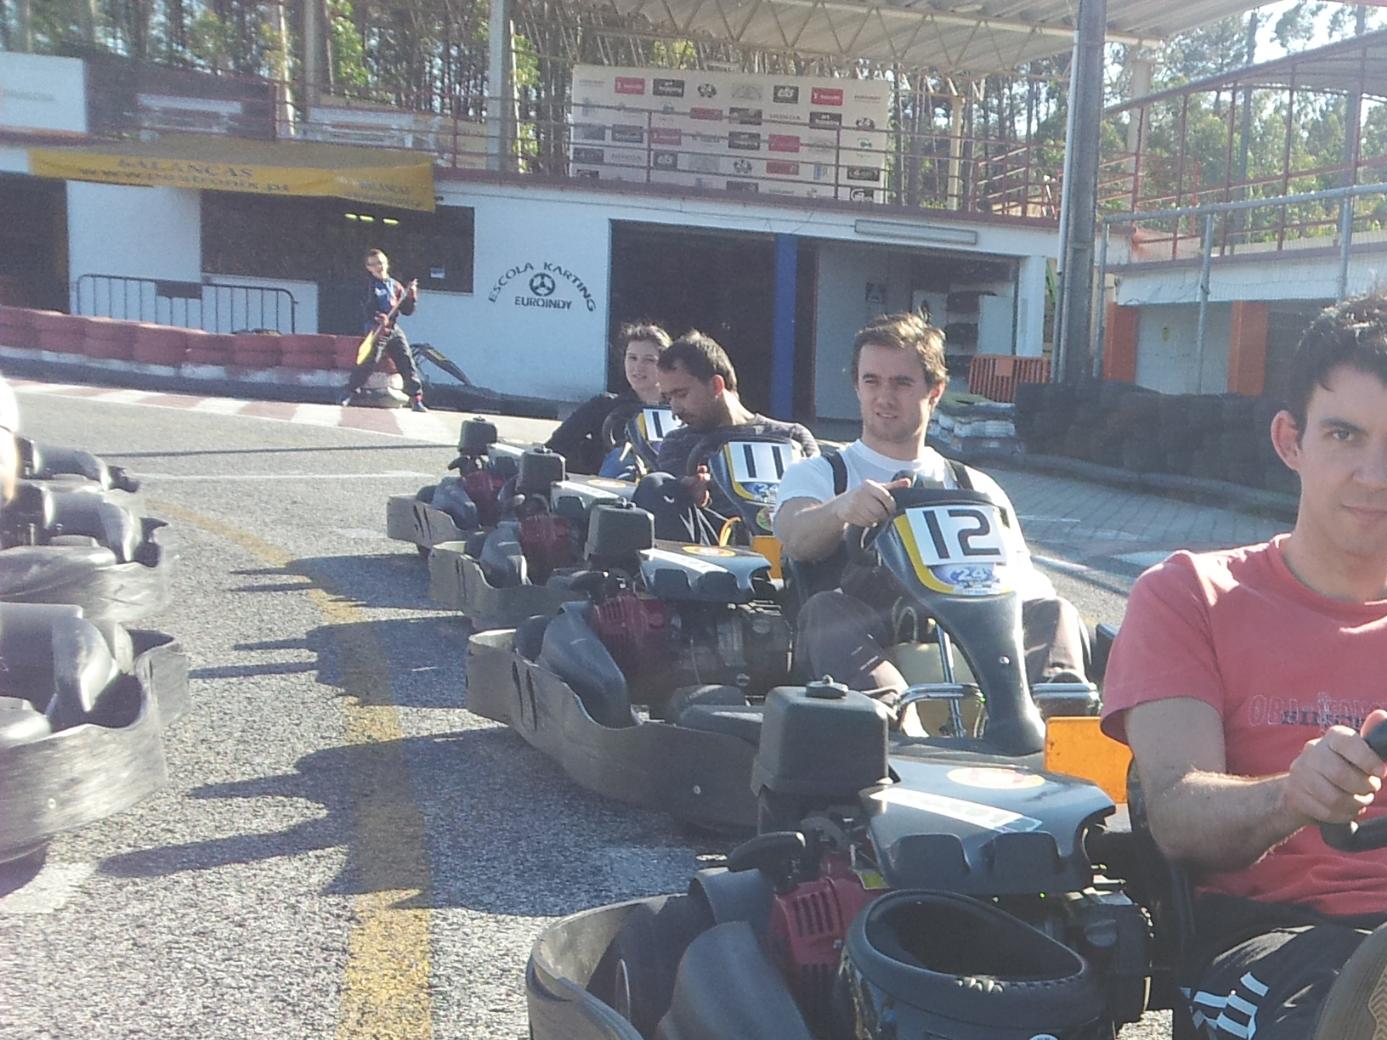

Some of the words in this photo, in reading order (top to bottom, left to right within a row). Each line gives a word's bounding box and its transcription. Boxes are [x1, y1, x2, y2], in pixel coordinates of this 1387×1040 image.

[488, 262, 534, 304] ESCOLA
[543, 262, 597, 312] KARTING
[514, 296, 573, 310] EUROINDY
[742, 444, 785, 480] 11
[922, 509, 1001, 560] 12
[958, 568, 987, 581] 24
